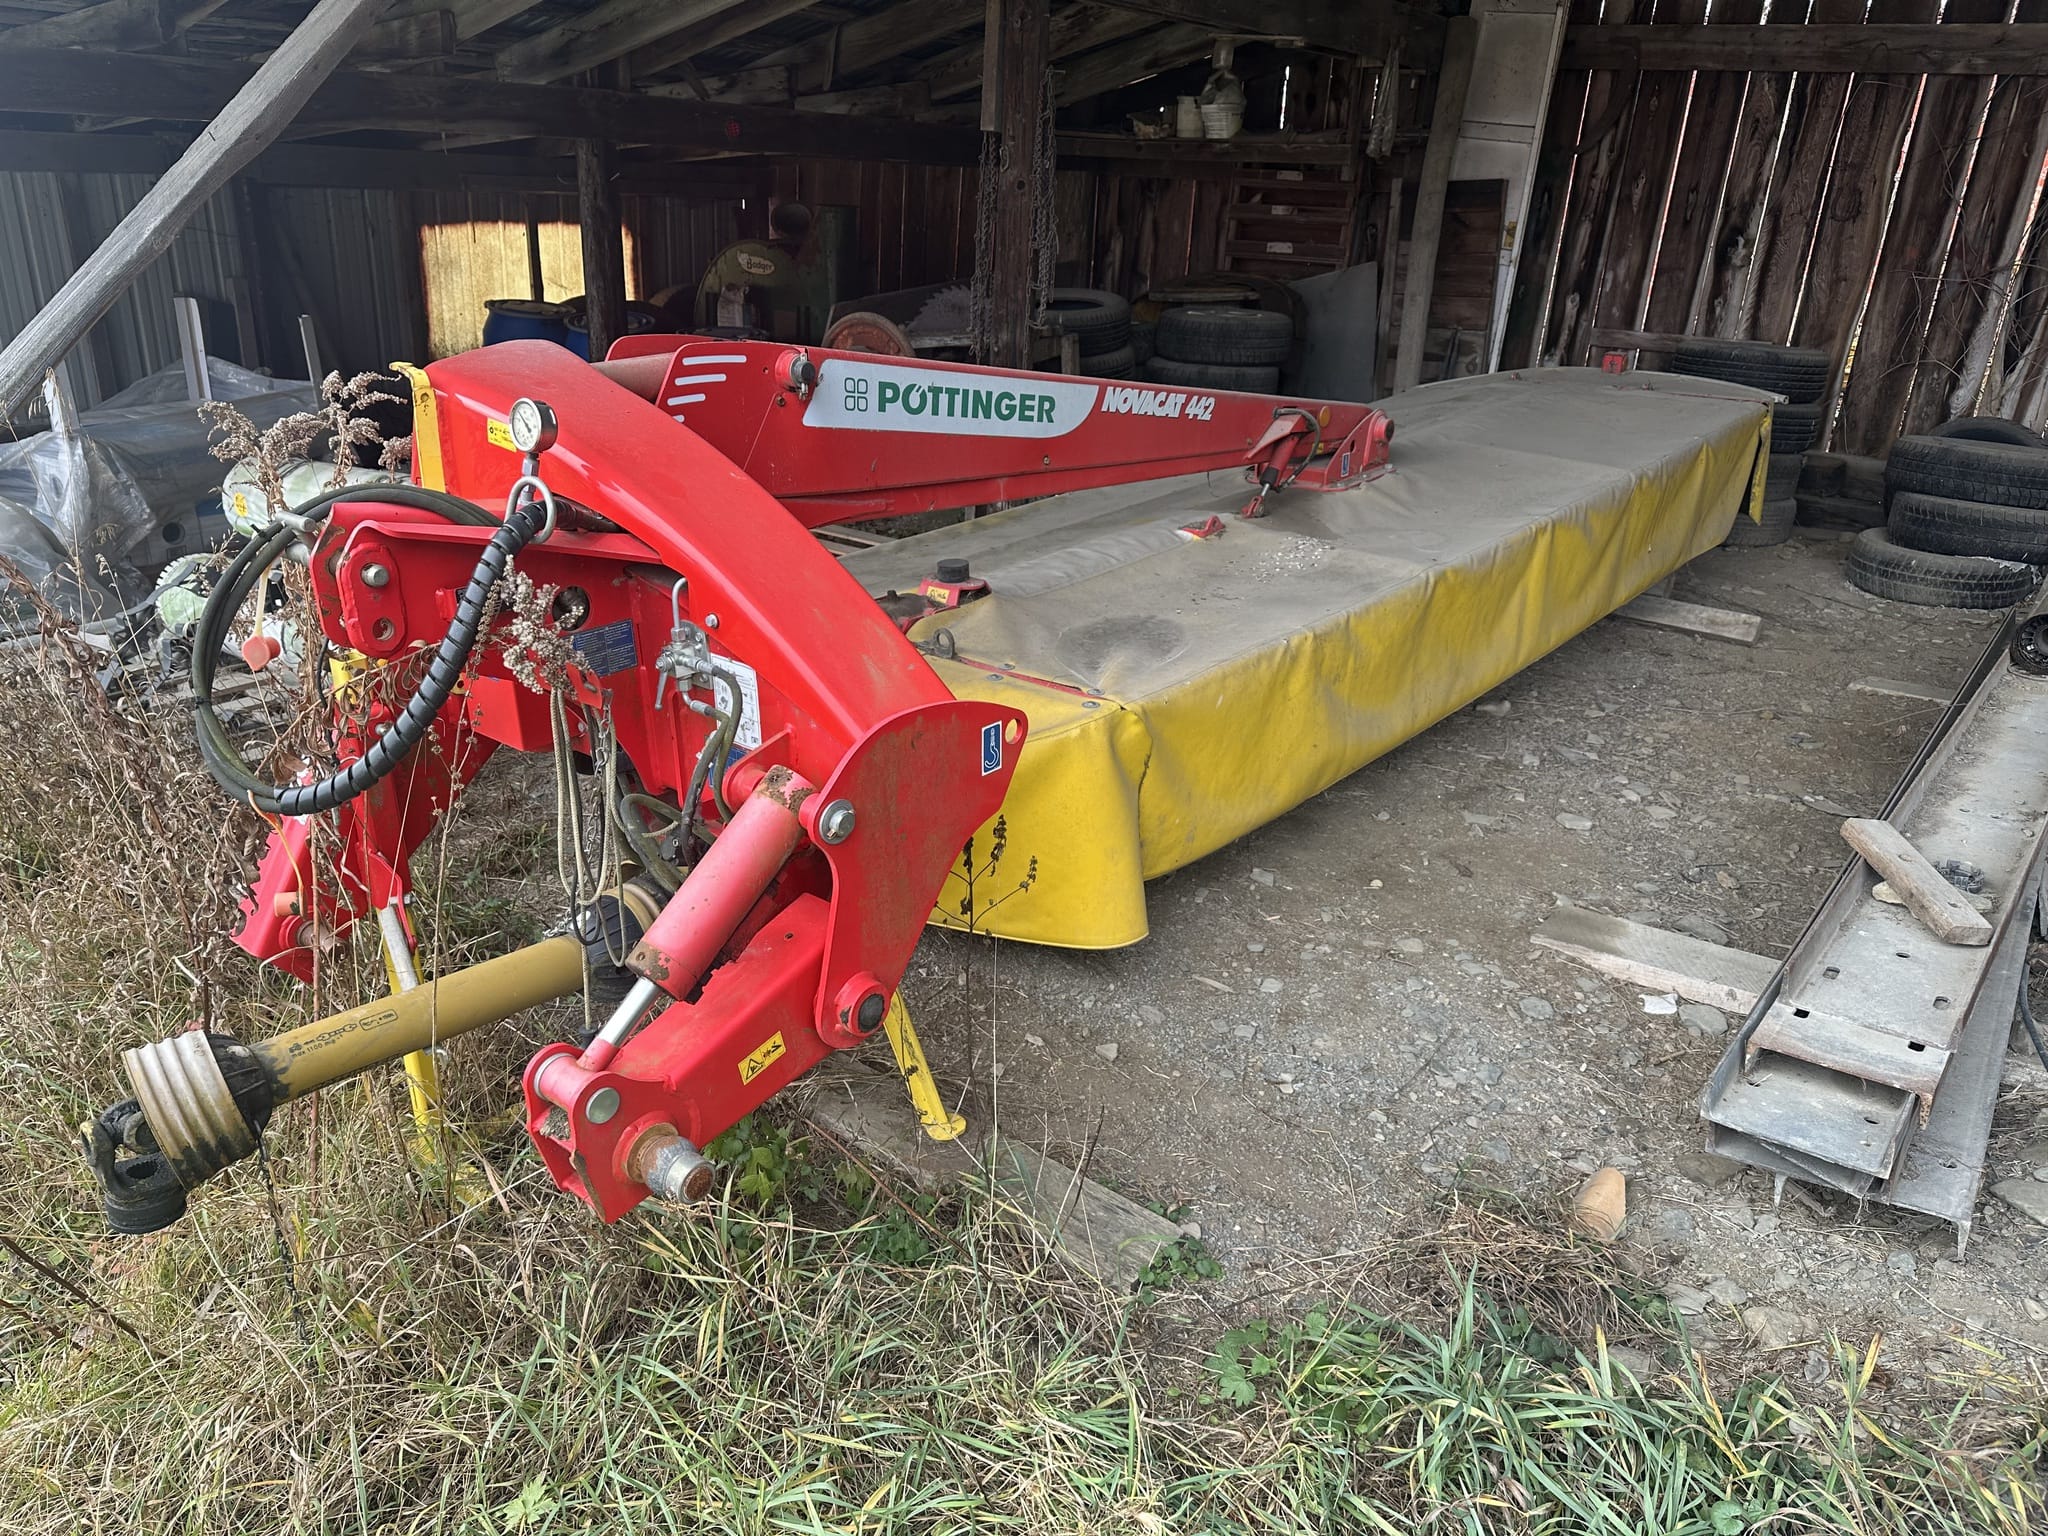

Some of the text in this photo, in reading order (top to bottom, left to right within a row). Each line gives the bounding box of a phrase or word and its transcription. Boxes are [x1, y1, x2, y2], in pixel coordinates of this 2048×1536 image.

[746, 258, 772, 273] Badger
[877, 380, 1057, 424] PÖTTINGER
[1100, 385, 1217, 422] NOVACAT 442
